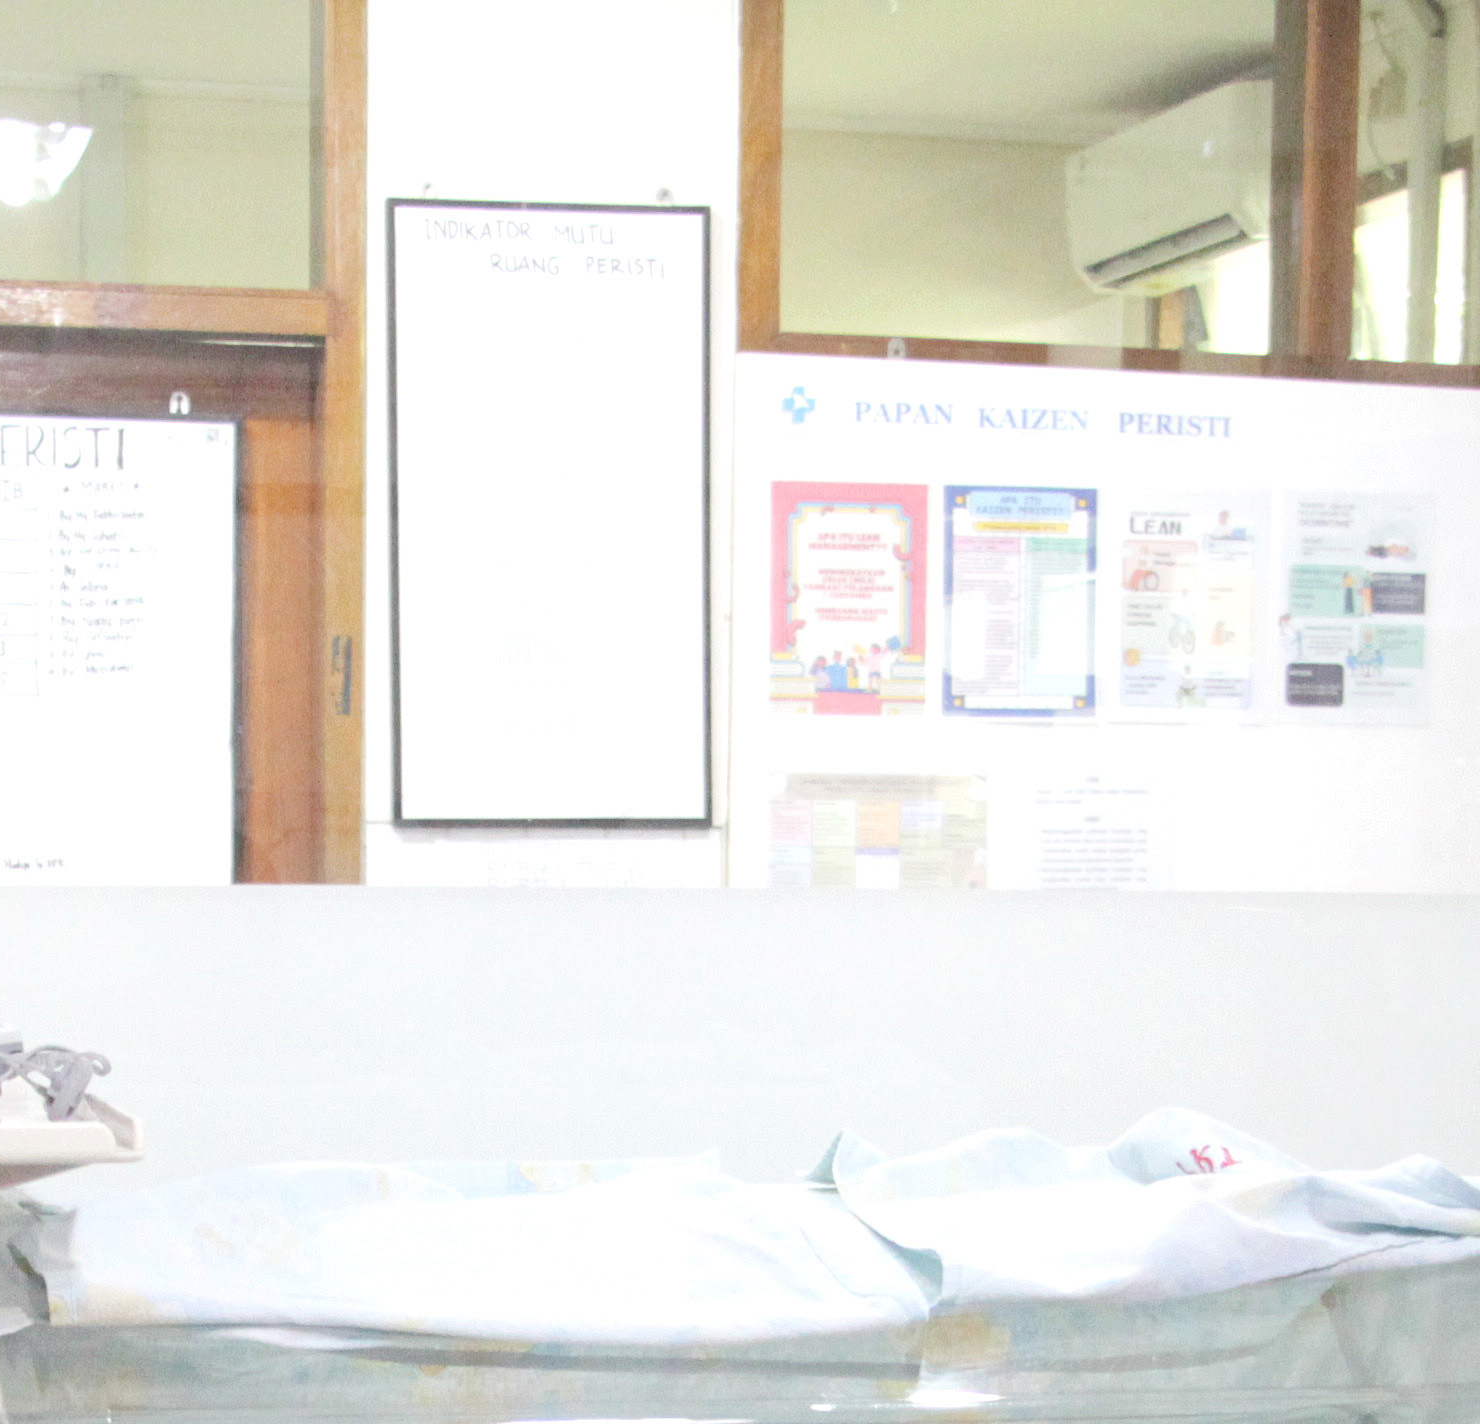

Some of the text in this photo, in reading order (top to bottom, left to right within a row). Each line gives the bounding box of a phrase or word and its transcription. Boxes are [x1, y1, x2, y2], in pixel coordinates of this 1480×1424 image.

[424, 218, 615, 245] INDIKATOR MUTU
[490, 253, 666, 279] RUANG PERISTI
[855, 401, 1232, 439] PAPAN KAIZEN PERISTI
[1129, 514, 1182, 536] LEAN
